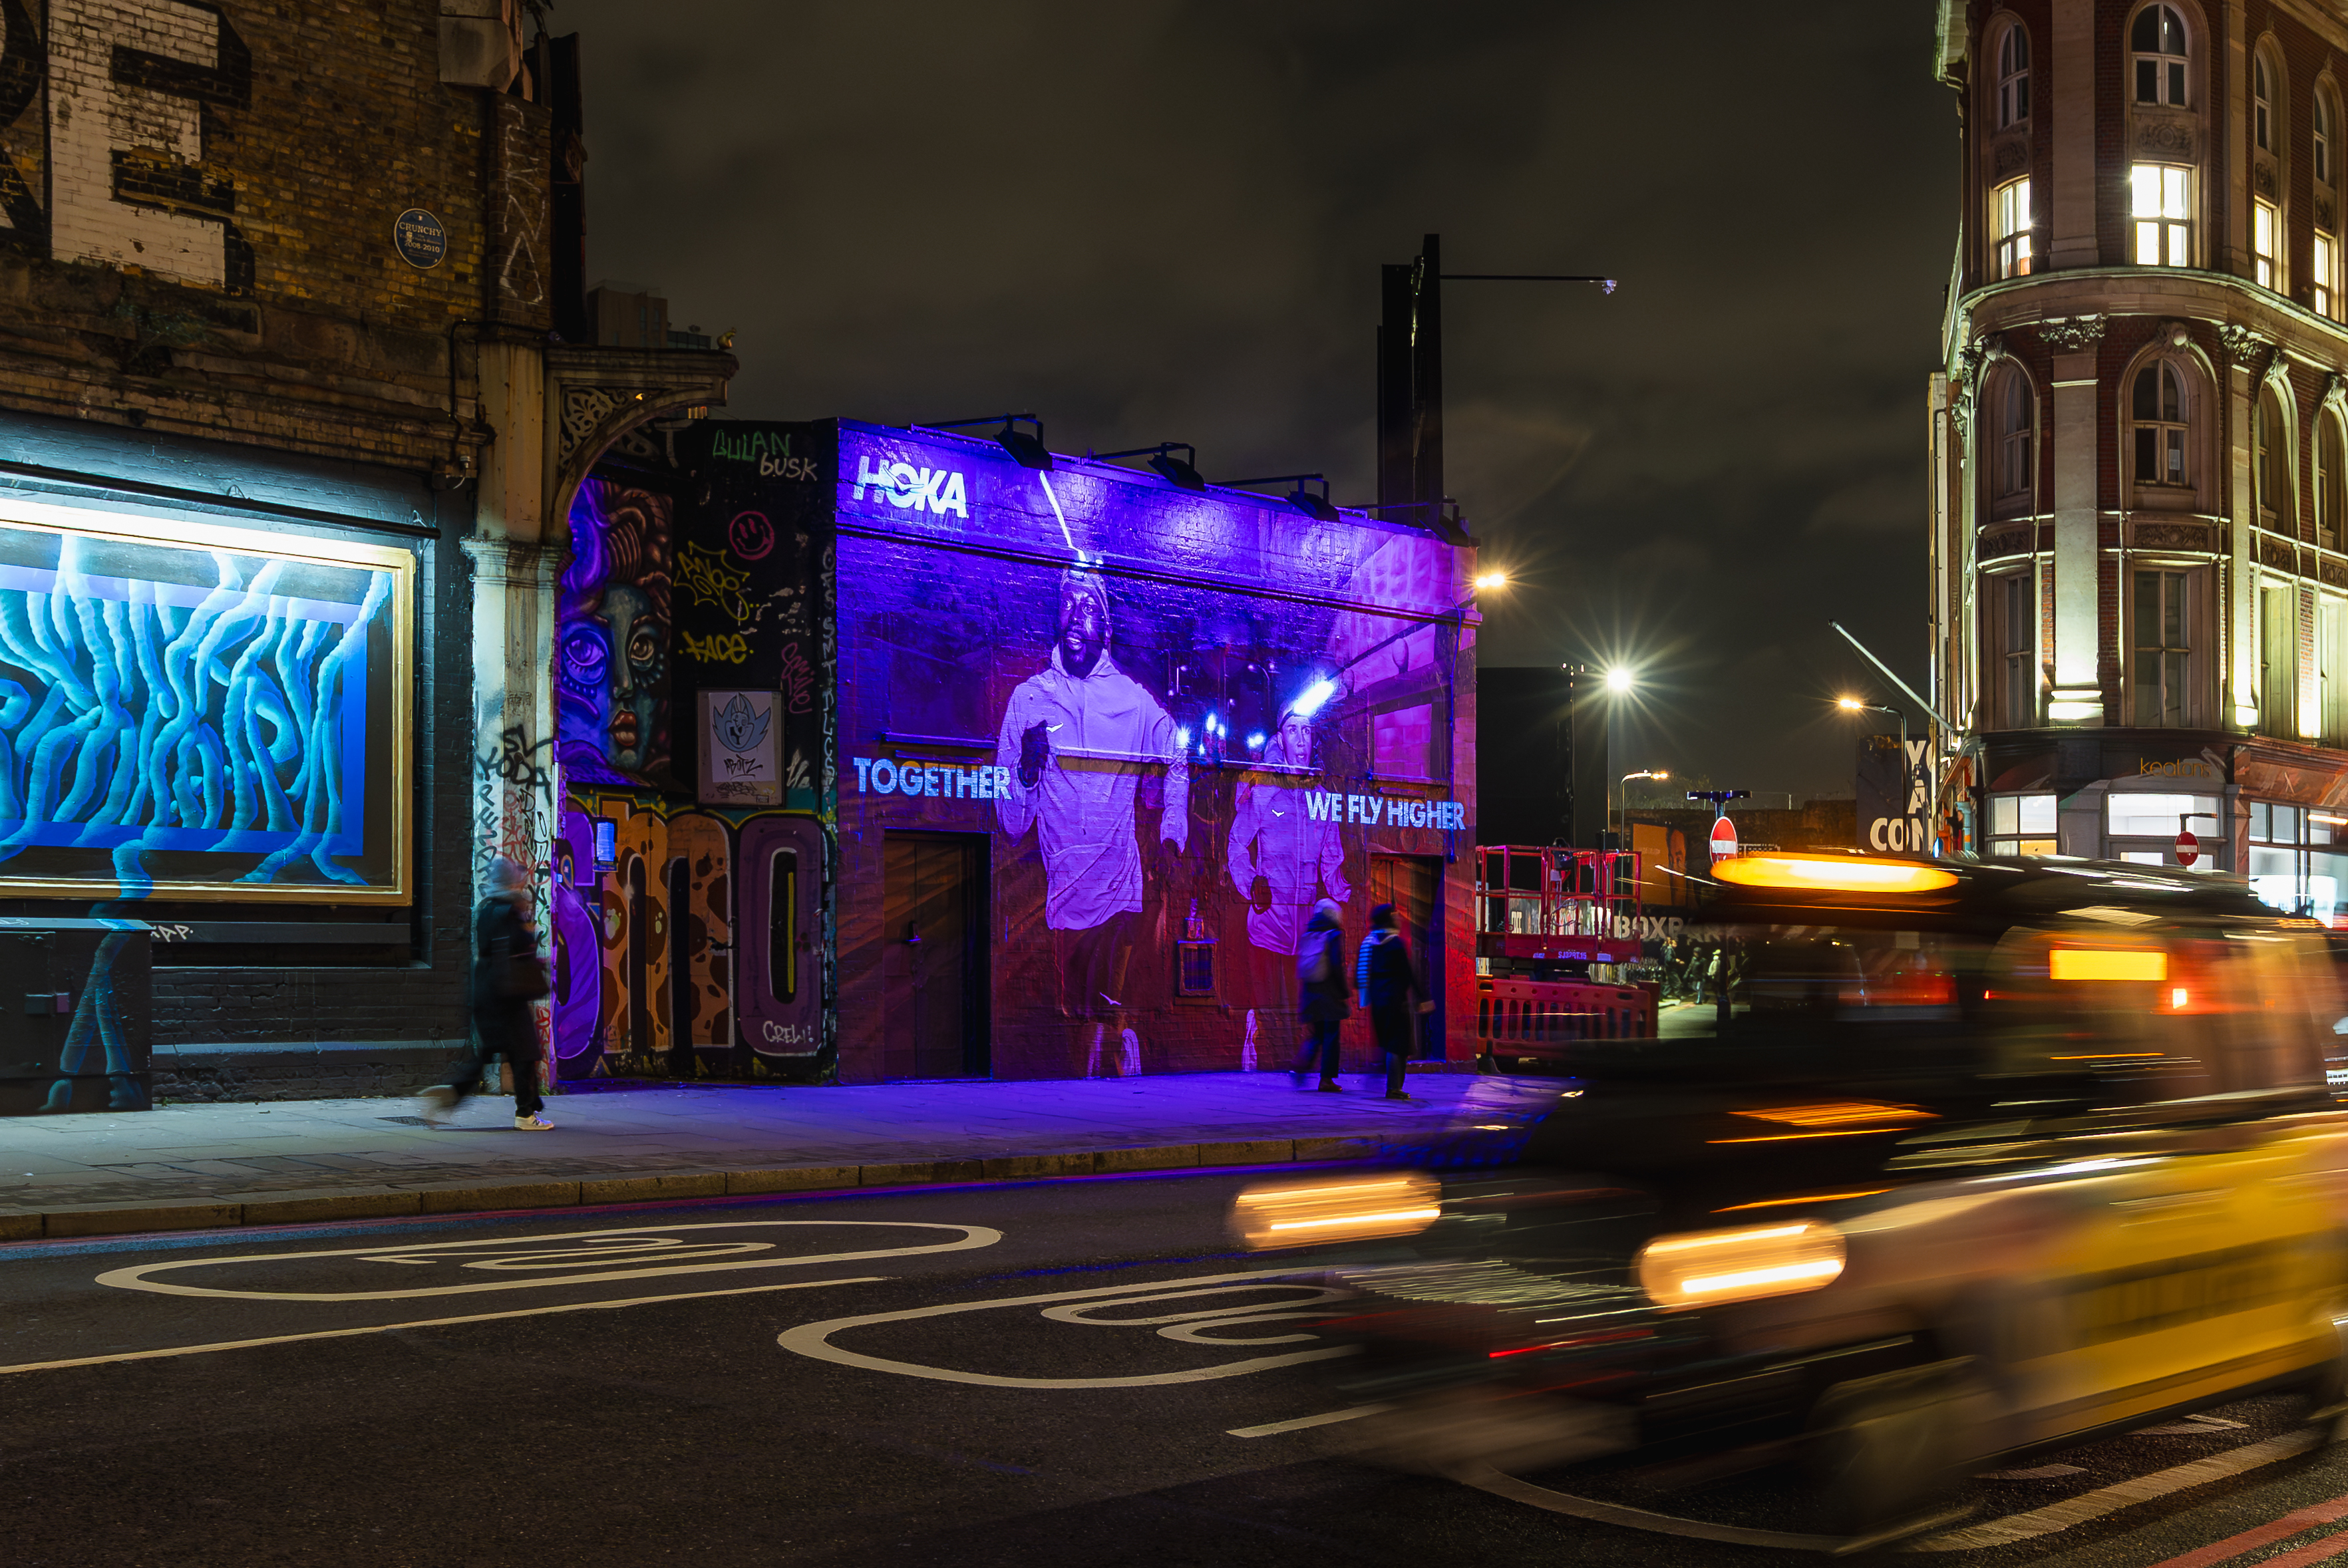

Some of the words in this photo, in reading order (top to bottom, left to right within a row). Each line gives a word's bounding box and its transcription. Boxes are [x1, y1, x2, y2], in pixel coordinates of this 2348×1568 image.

[399, 222, 441, 236] CRUNCHY
[853, 455, 969, 518] HOKA
[853, 757, 1013, 800] TOGETHER
[1305, 790, 1343, 822] WE
[1348, 794, 1383, 824] FLY
[1387, 797, 1466, 830] HIGHER
